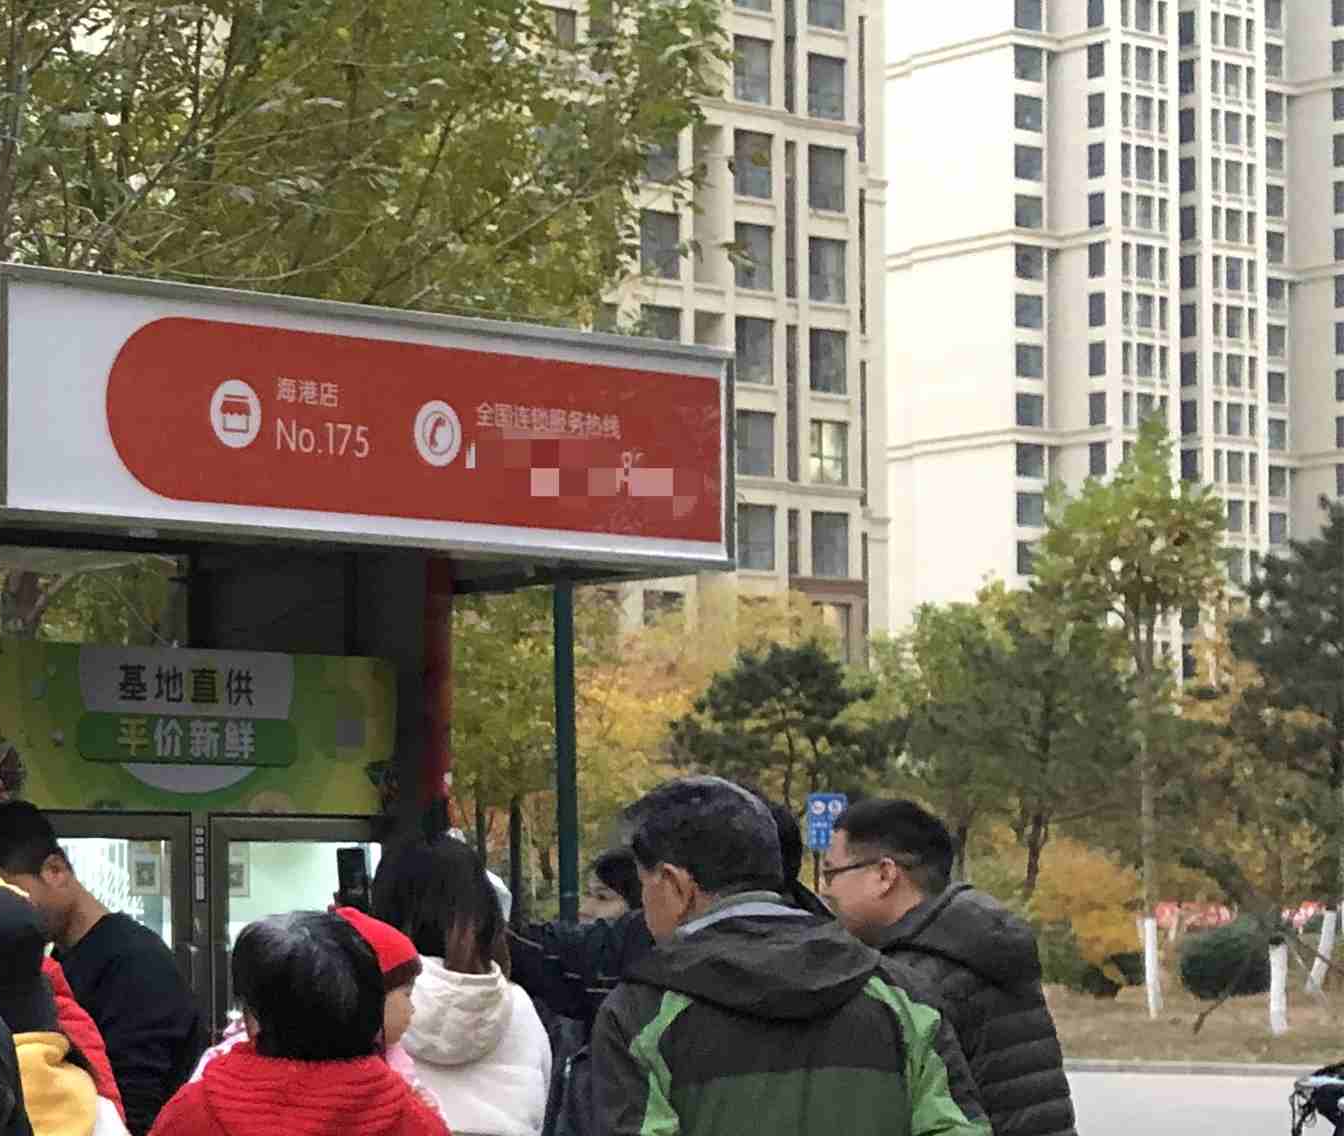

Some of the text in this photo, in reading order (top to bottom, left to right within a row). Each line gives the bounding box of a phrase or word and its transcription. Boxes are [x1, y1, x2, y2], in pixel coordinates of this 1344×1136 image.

[276, 376, 339, 408] 海港店
[276, 418, 369, 458] No.175
[119, 664, 255, 706] 基地直供
[117, 716, 255, 759] 平价新鲜
